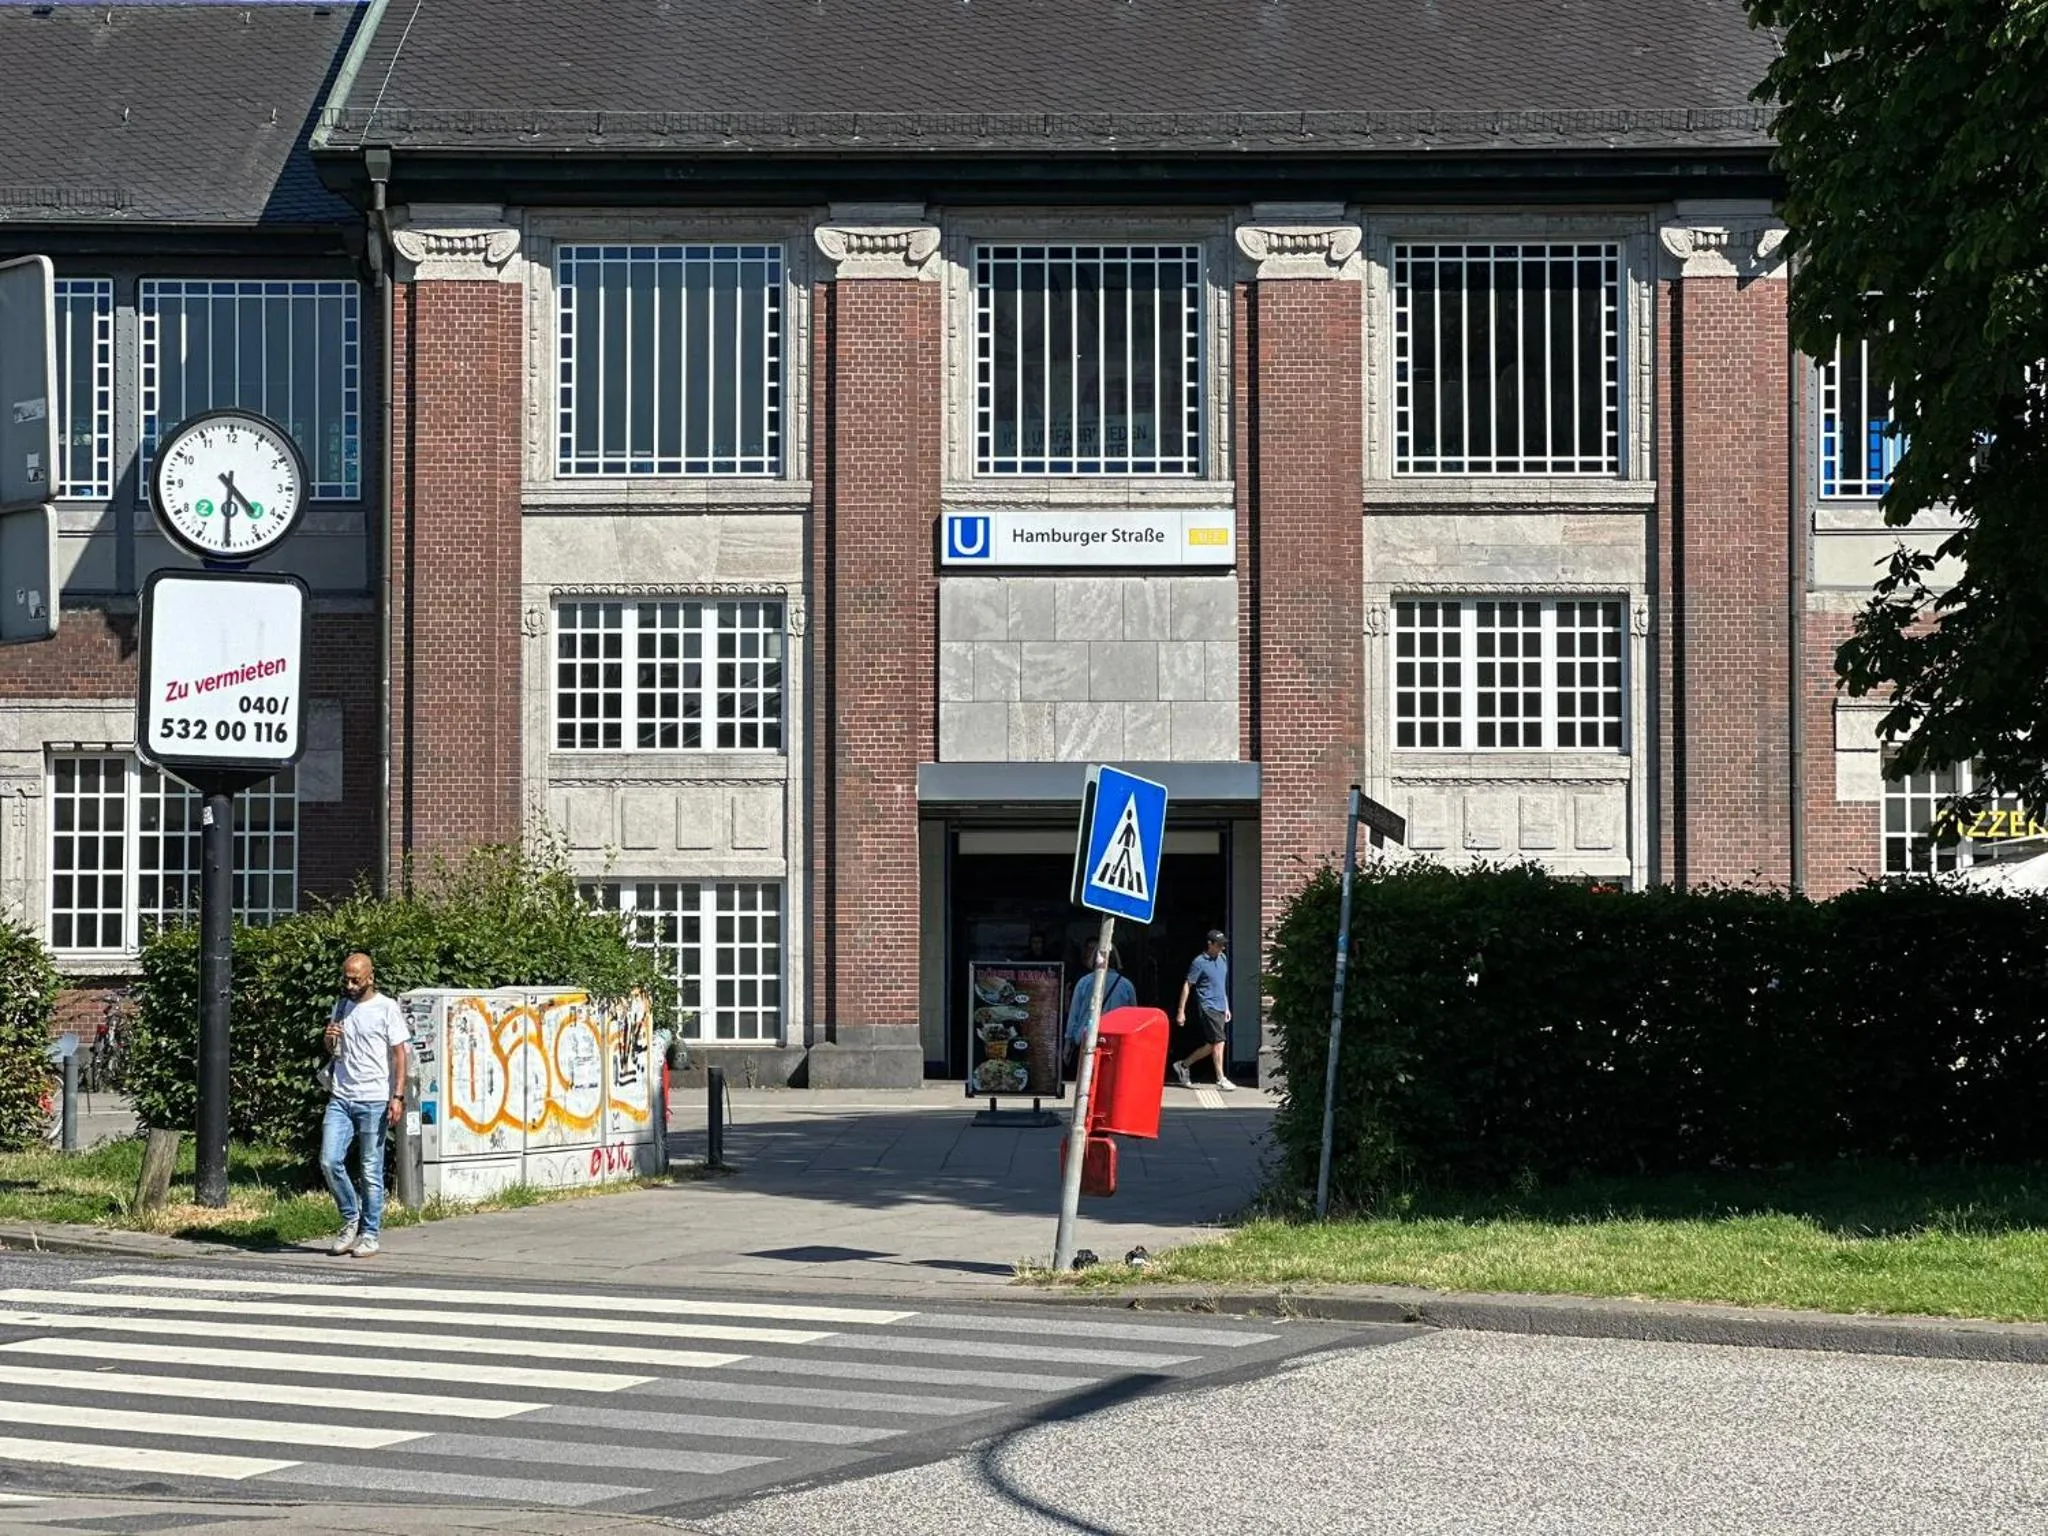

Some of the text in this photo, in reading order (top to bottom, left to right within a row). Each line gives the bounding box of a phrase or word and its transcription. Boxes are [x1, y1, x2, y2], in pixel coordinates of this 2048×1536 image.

[203, 439, 213, 449] 11
[226, 433, 238, 444] 12
[183, 455, 195, 466] 10
[271, 459, 278, 470] 2
[177, 479, 184, 489] 9
[276, 483, 284, 494] 3
[183, 502, 190, 513] 8
[269, 506, 277, 517] 4
[251, 524, 258, 534] 5
[953, 518, 985, 555] U
[1012, 527, 1165, 547] Hamburger Straße
[165, 657, 287, 702] Zu vermieten
[239, 695, 290, 716] 040/
[160, 718, 288, 743] 532 00 116
